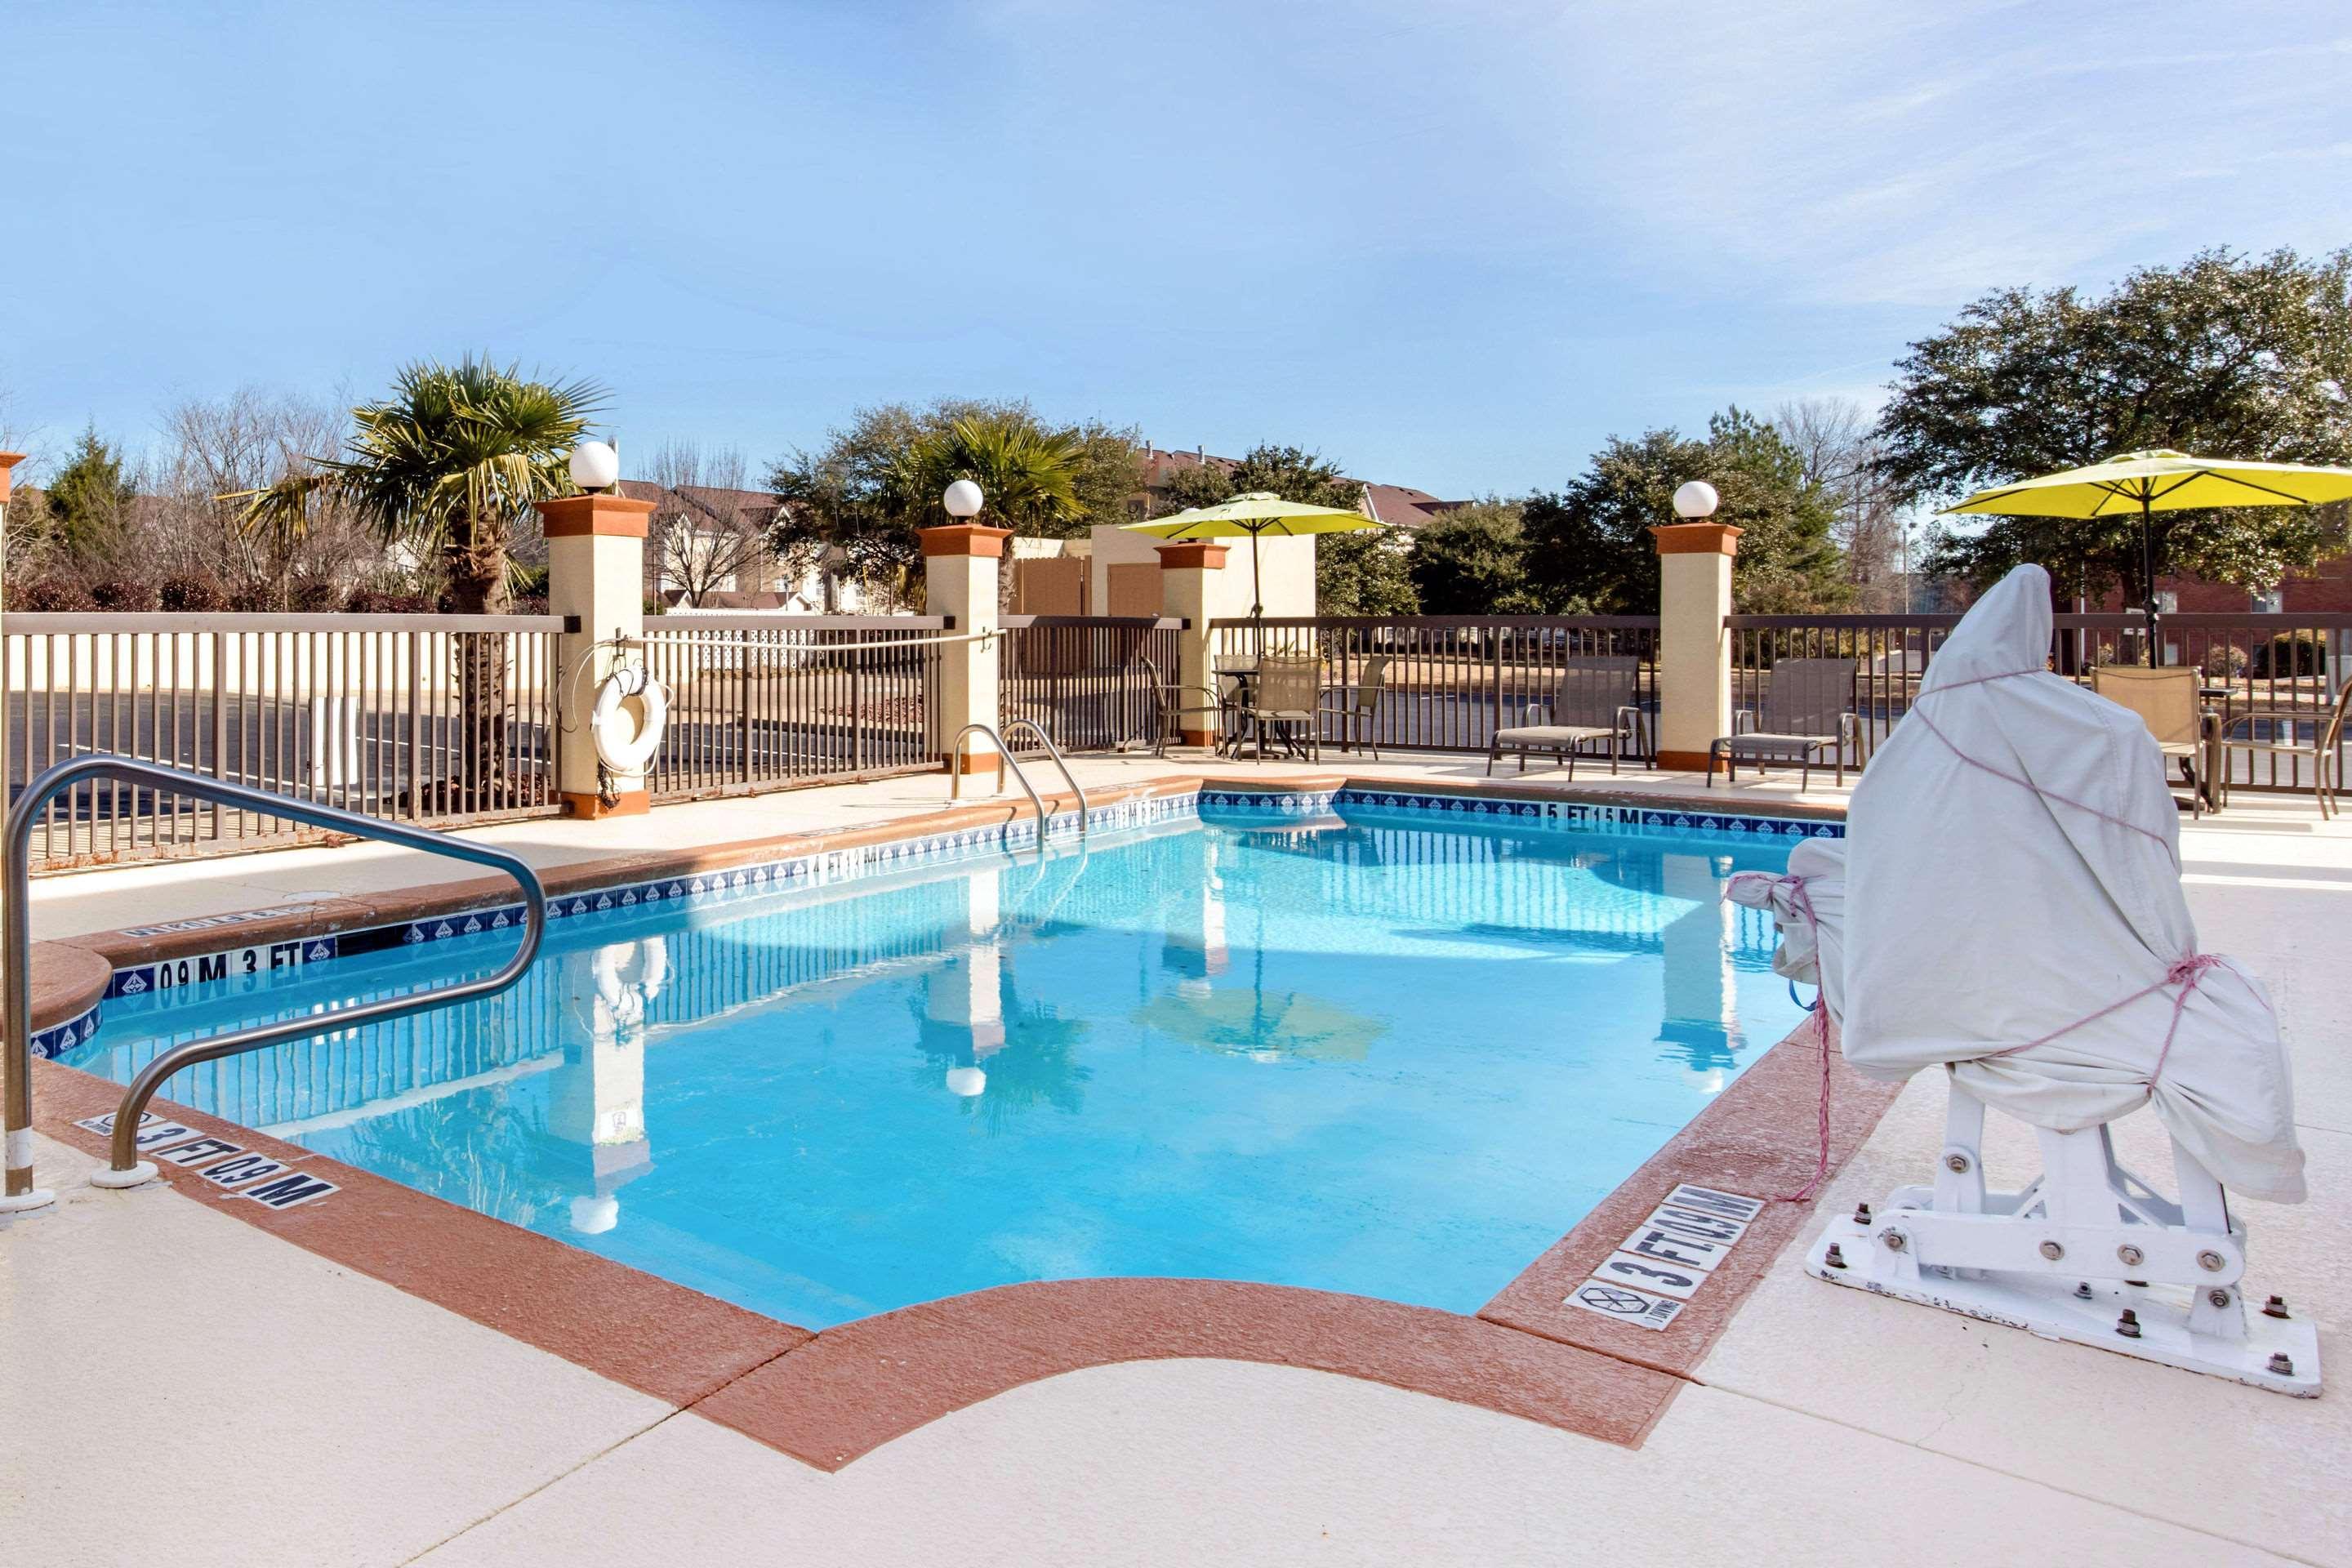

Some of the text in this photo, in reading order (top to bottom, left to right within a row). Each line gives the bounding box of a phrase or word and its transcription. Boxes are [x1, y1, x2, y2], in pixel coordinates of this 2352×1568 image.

[1567, 805, 1589, 820] FT
[1619, 808, 1639, 824] M
[198, 953, 227, 982] M
[242, 949, 257, 974] 3
[270, 941, 301, 970] FT
[136, 1127, 334, 1207] 3 FT 0.9 M
[1673, 1187, 1759, 1218] M
[1653, 1209, 1740, 1240] 0.9
[1609, 1261, 1694, 1287] 3
